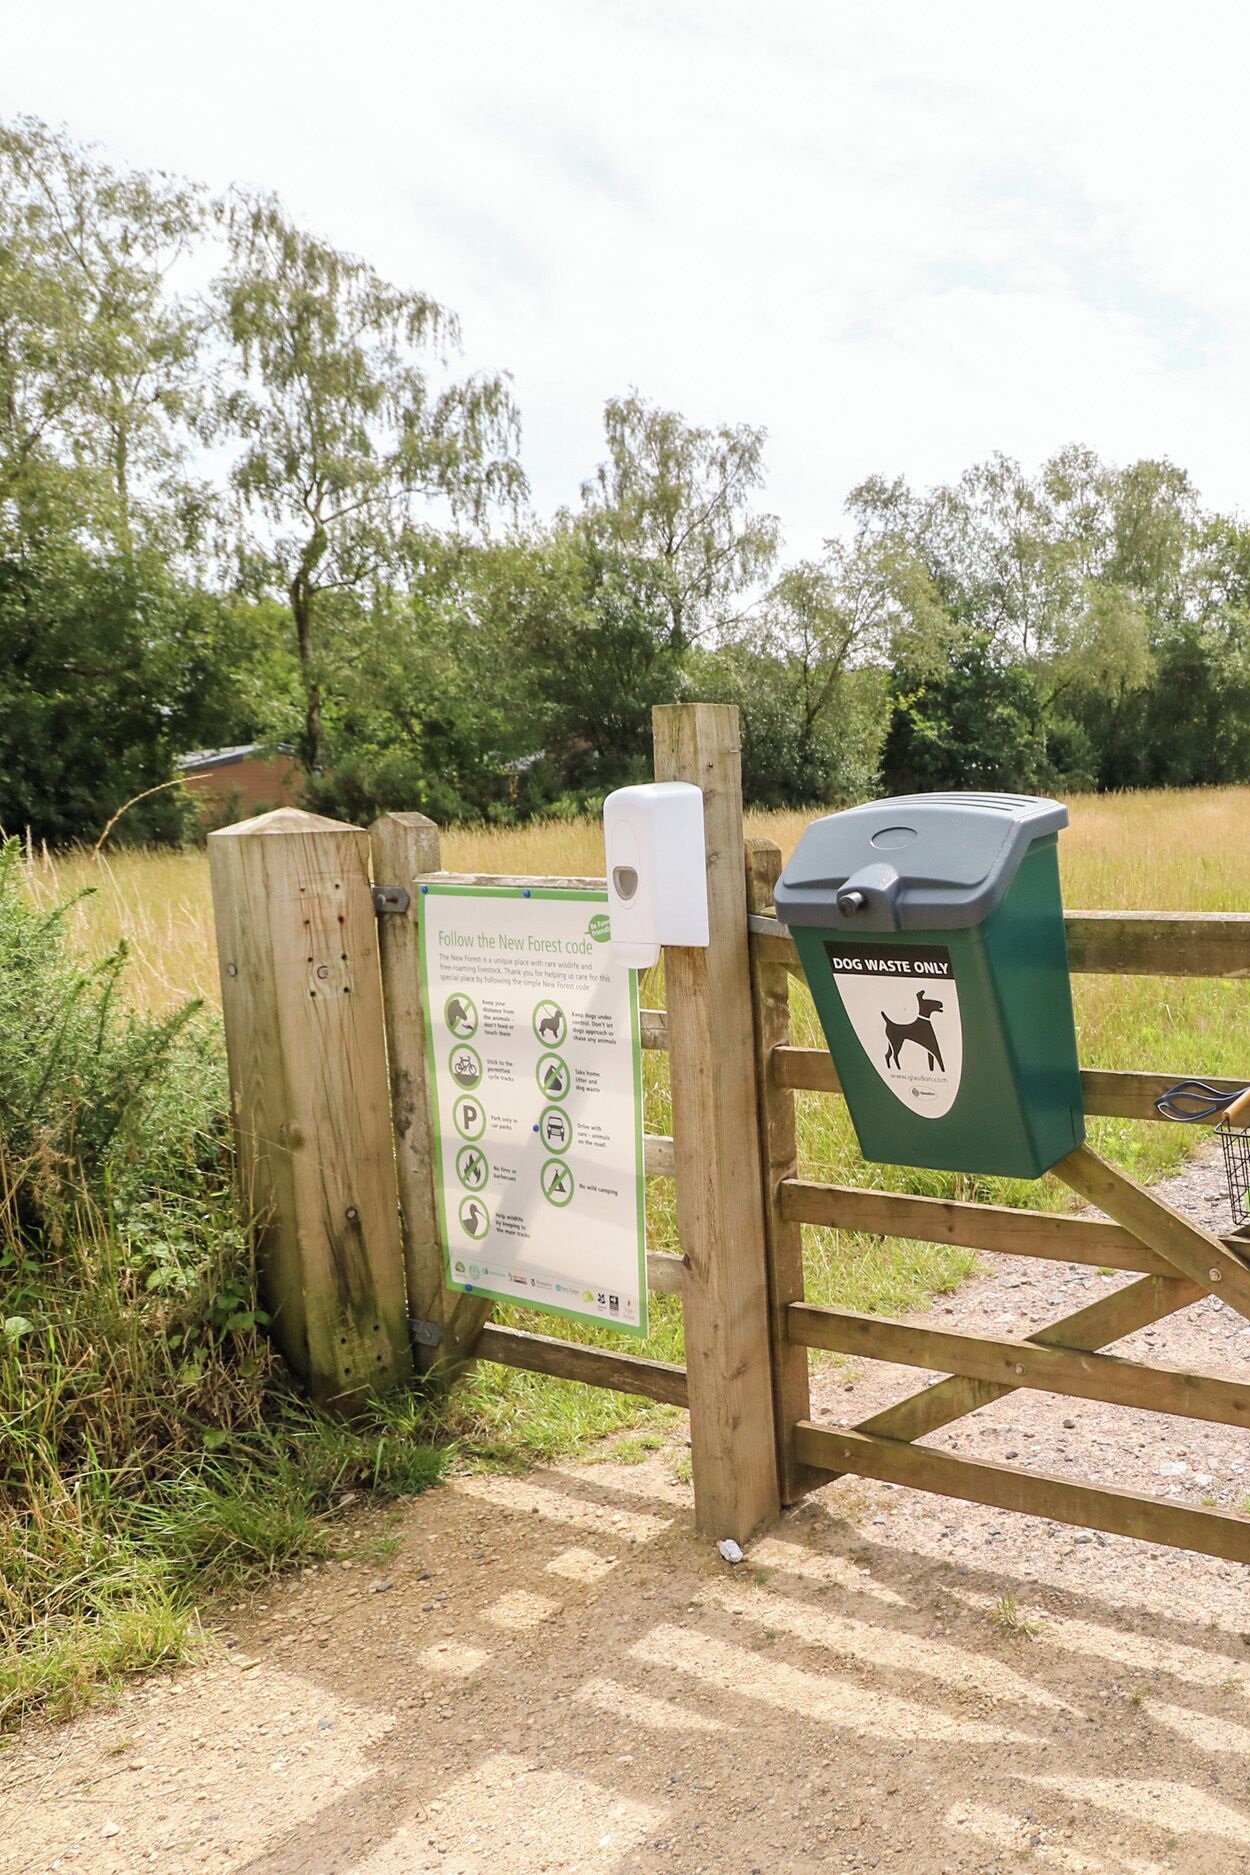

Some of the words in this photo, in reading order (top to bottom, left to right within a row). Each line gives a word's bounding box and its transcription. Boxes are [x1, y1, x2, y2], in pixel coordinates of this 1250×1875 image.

[438, 930, 473, 947] Follow
[477, 933, 495, 949] the
[498, 934, 523, 950] New
[528, 936, 562, 953] Forest
[565, 939, 592, 955] code
[832, 957, 863, 971] DOG
[863, 958, 912, 973] WASTE
[913, 961, 948, 975] ONLY
